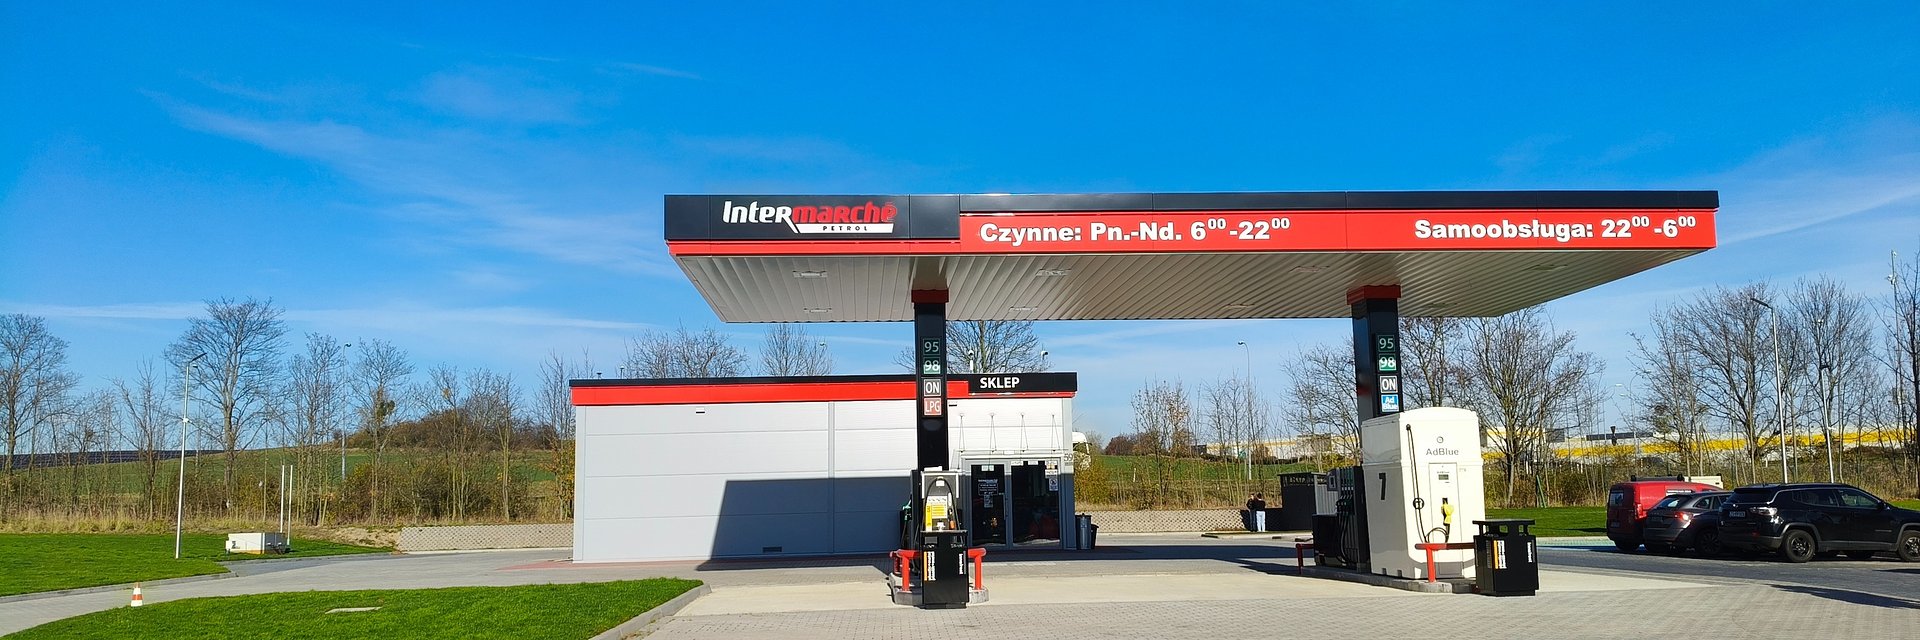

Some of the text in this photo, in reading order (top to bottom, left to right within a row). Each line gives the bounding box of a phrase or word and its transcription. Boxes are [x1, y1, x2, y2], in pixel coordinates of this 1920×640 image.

[979, 223, 1081, 247] Czynne:
[1090, 221, 1182, 241] Pn.-Nd.
[1414, 219, 1594, 242] Samoobsługa:
[924, 341, 939, 352] 95
[1379, 338, 1394, 349] 95
[924, 360, 940, 371] 98
[1379, 356, 1396, 368] 98
[925, 381, 940, 394] ON
[979, 376, 1020, 389] SKLEP
[1381, 378, 1396, 391] ON
[925, 401, 940, 412] LPG
[1425, 448, 1459, 456] AdBlue
